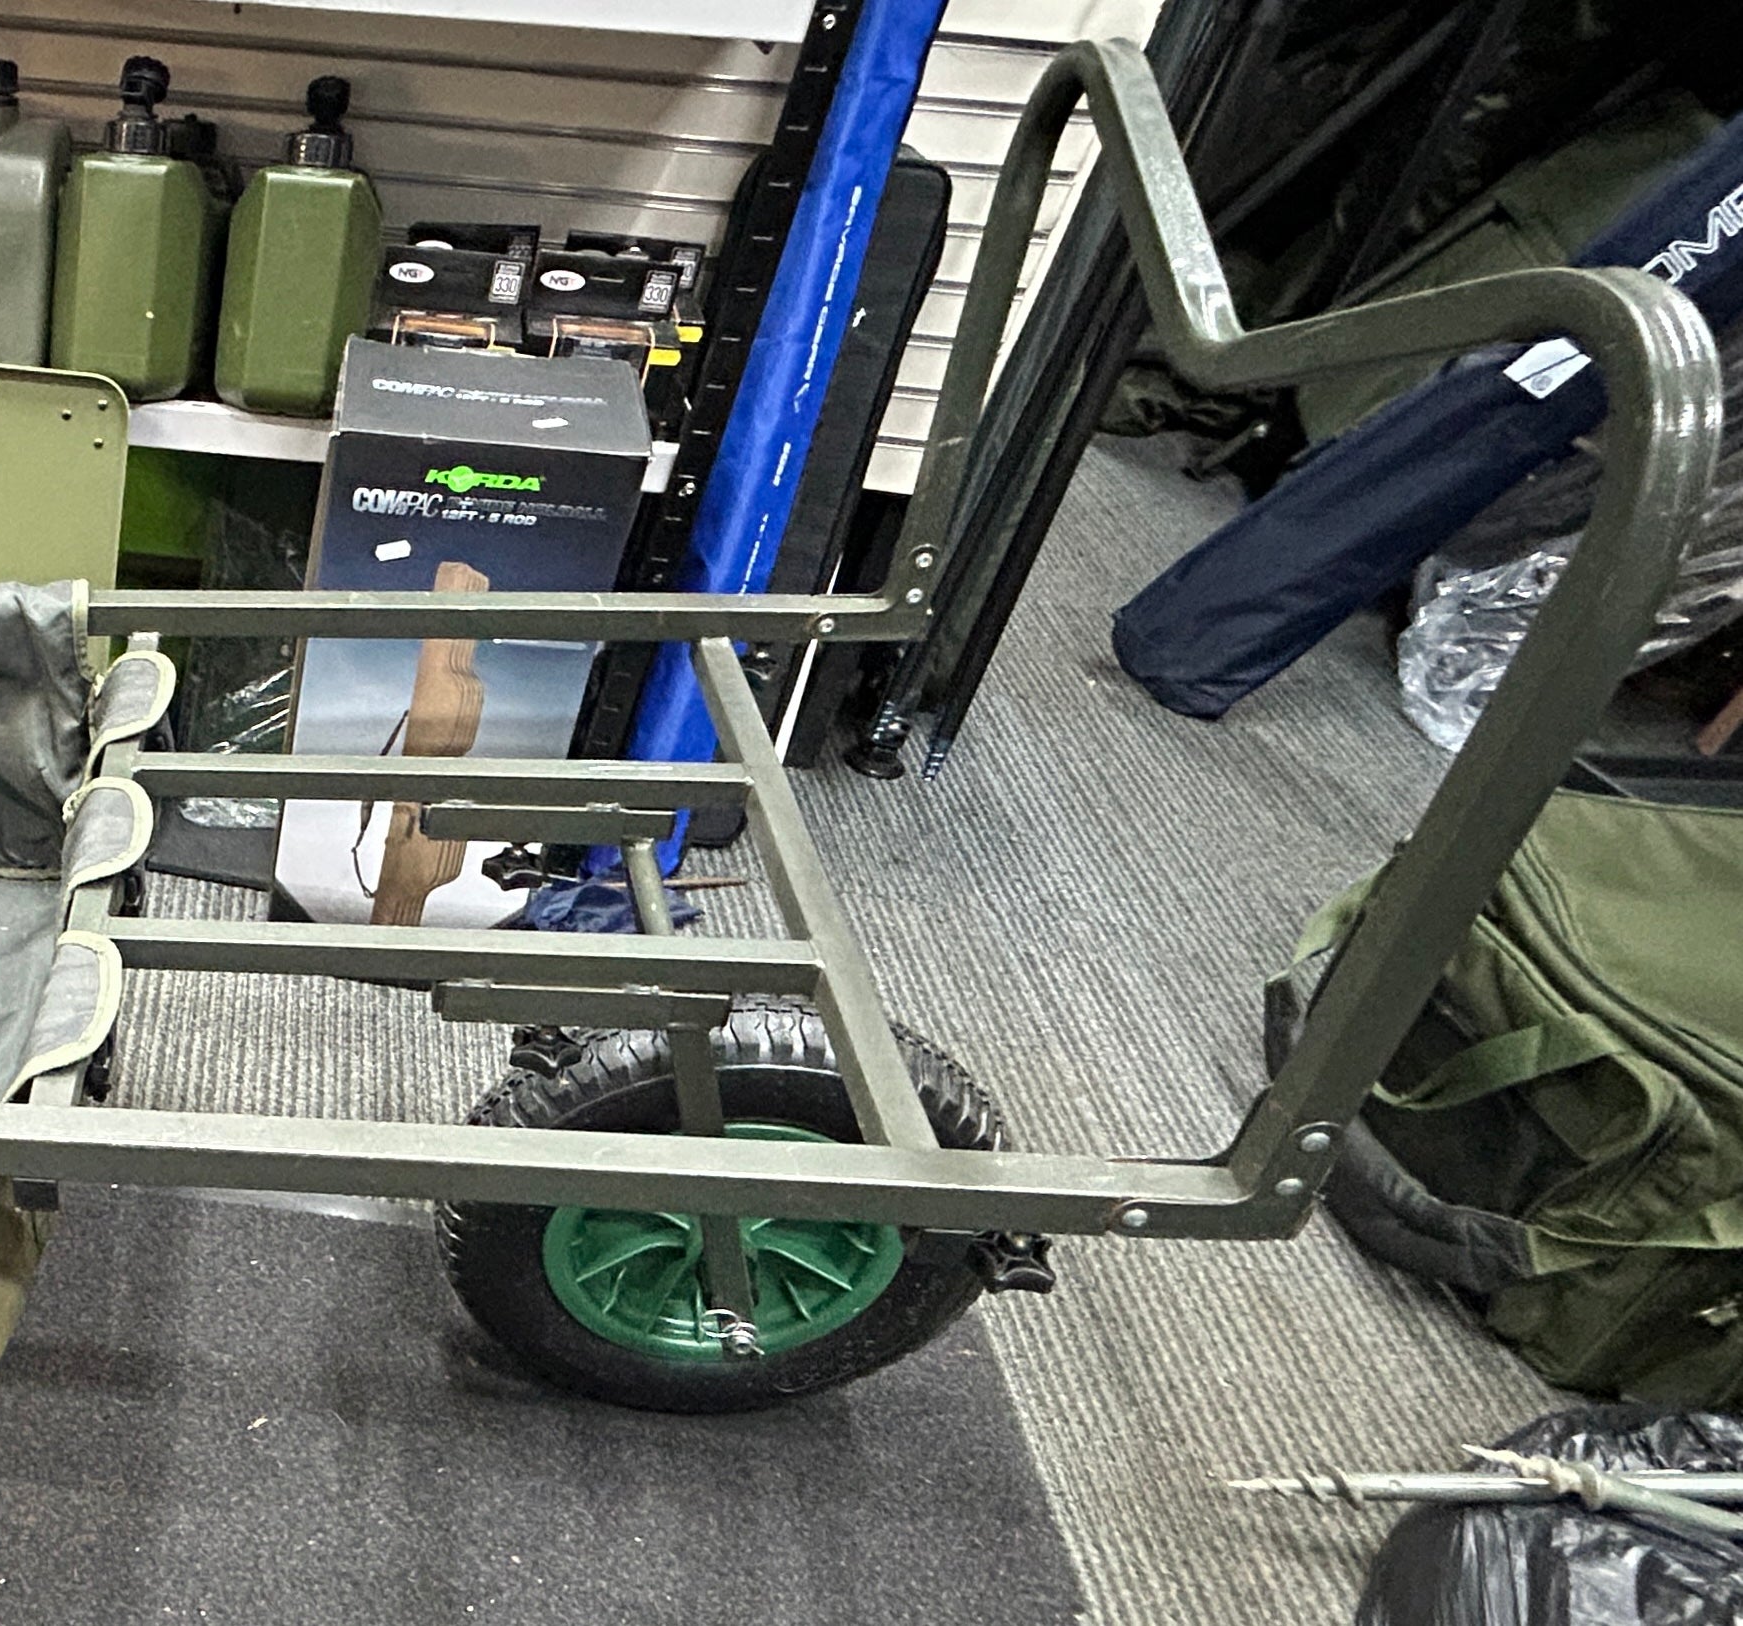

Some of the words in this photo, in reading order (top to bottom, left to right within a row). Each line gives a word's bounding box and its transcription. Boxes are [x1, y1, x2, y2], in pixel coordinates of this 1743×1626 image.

[495, 277, 518, 293] 330
[645, 286, 669, 302] 330
[372, 377, 455, 399] COMPAC
[424, 465, 541, 493] KORDA
[352, 487, 443, 518] COMPAC
[502, 513, 537, 527] ROD
